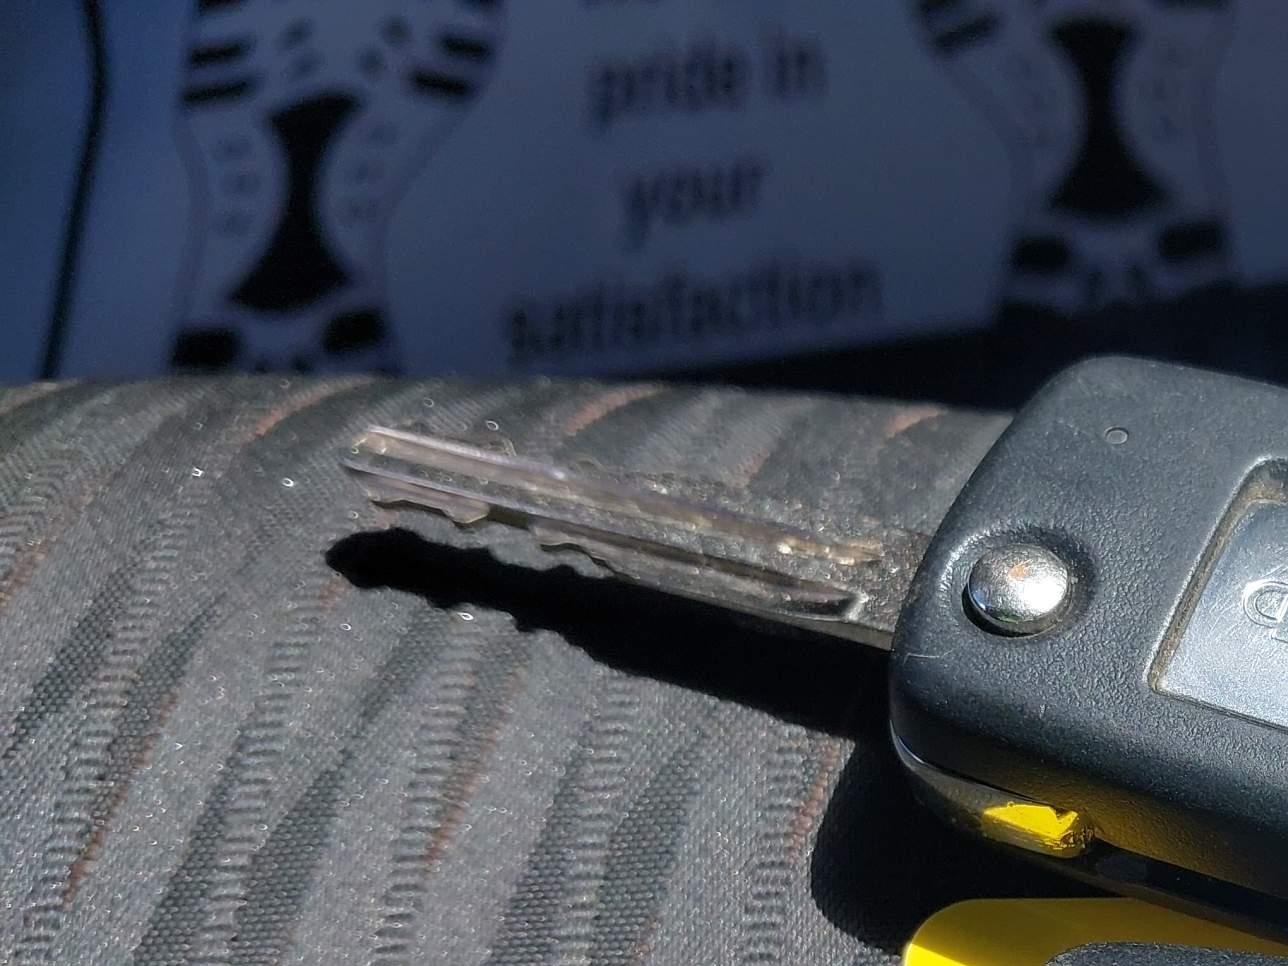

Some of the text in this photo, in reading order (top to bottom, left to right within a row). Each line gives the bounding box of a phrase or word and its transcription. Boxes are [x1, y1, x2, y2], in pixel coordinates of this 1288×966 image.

[588, 30, 826, 128] pride in
[622, 157, 763, 248] your
[507, 250, 880, 364] satisfaction
